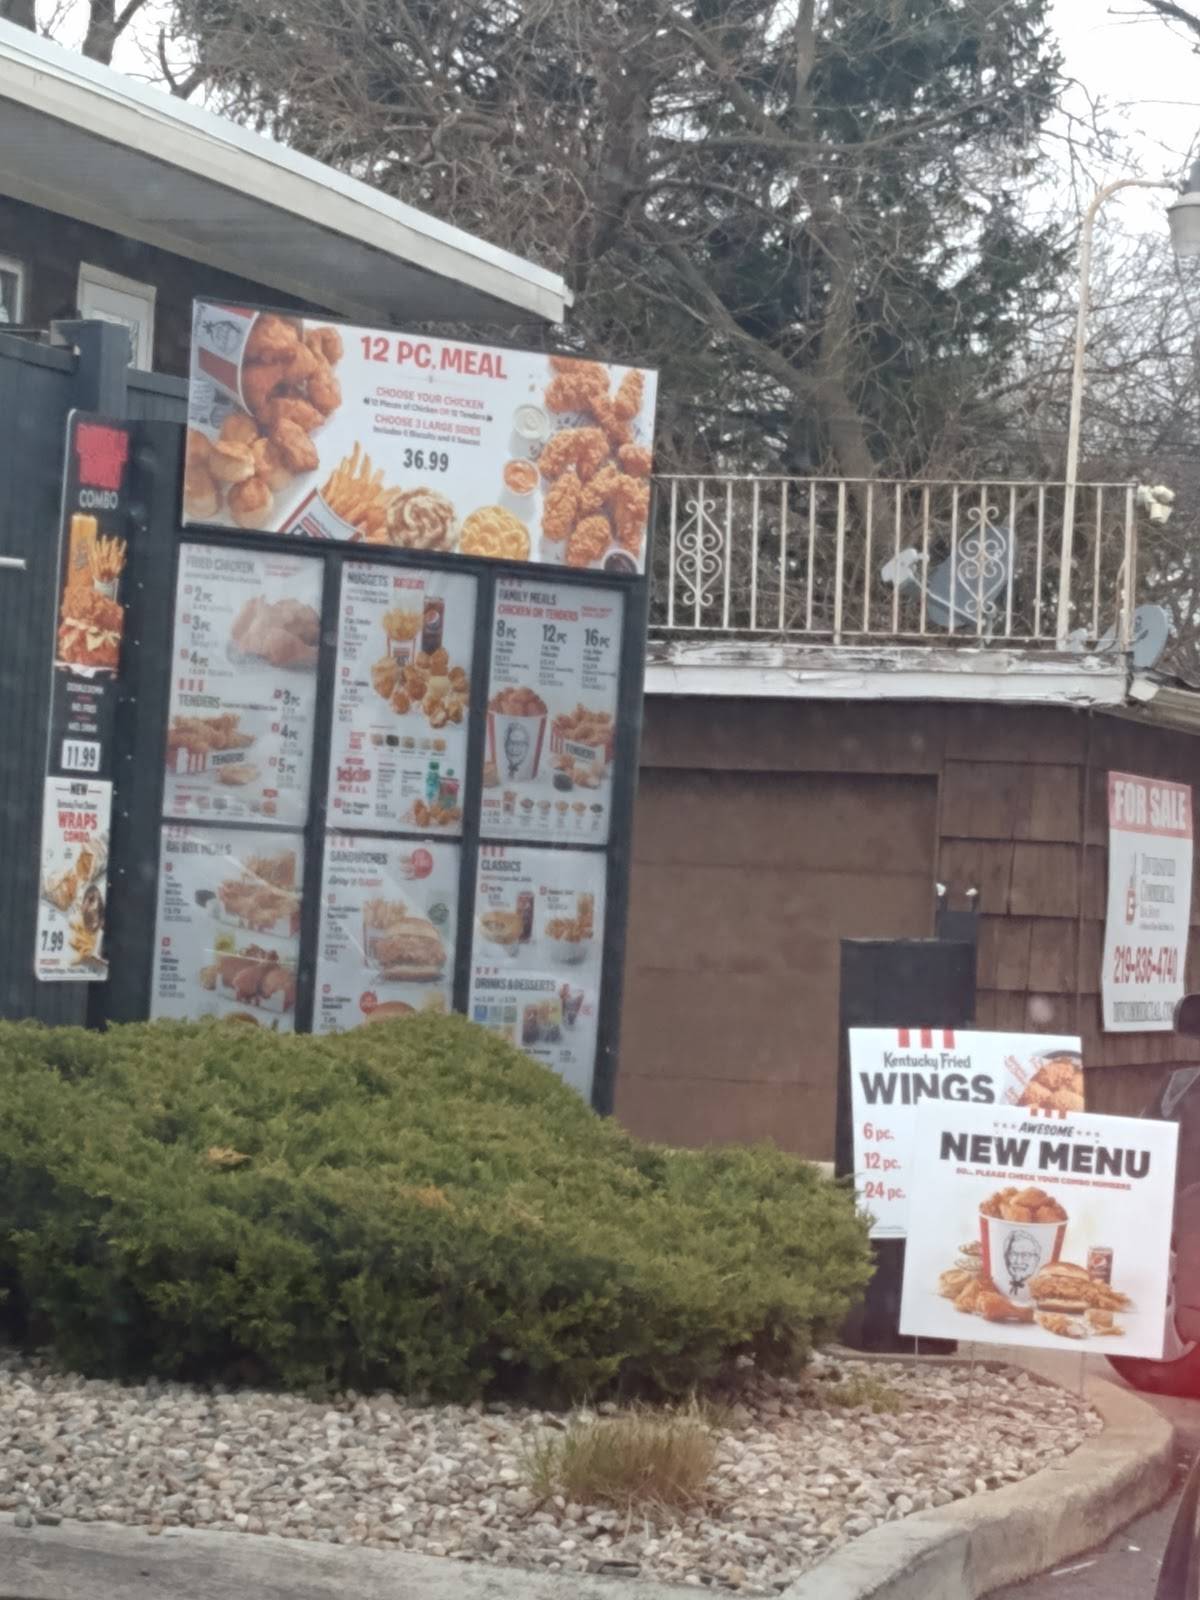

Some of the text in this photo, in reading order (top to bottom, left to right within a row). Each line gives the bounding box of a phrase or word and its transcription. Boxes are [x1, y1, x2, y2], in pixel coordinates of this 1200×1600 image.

[361, 336, 508, 380] 12 PC. MEAL
[376, 386, 485, 410] CHOOSE YOUR CHICKEN
[380, 399, 402, 409] Pieces
[403, 402, 411, 411] of
[412, 403, 438, 414] Chicken
[439, 407, 450, 415] OR
[460, 410, 486, 421] Tenders
[373, 425, 402, 436] Includes
[437, 434, 450, 443] and
[375, 413, 414, 428] CHOOSE
[422, 419, 453, 432] LARGE
[455, 424, 481, 436] SIDES
[403, 447, 449, 472] 36.99
[79, 489, 119, 510] COMBO
[186, 555, 213, 570] FRIED
[214, 558, 255, 574] CHICKEN
[499, 588, 557, 606] FAMILY MEALS
[498, 604, 531, 617] CHICKEN
[178, 694, 221, 709] TENDERS
[67, 745, 96, 768] 11.99
[70, 783, 88, 796] NEW
[1114, 780, 1186, 830] FOR SALE
[57, 811, 98, 830] WRAPS
[64, 831, 90, 843] COMBO
[481, 859, 521, 873] CLASSICS
[41, 930, 64, 951] 7.99
[474, 977, 507, 990] DRINKS
[513, 979, 556, 992] DESSERTS
[883, 1051, 971, 1071] Kentucky Fried
[860, 1071, 996, 1105] WINGS
[863, 1122, 894, 1142] 6 pc.
[1018, 1121, 1075, 1138] AWESOME
[864, 1152, 902, 1172] 12 pc.
[939, 1130, 1151, 1180] NEW MENU
[975, 1169, 1006, 1180] PLEASE
[1008, 1172, 1036, 1182] CHECK
[1038, 1174, 1060, 1184] YOUR
[1061, 1177, 1090, 1187] COMBO
[1092, 1180, 1132, 1191] NUMBERS
[865, 1181, 906, 1202] 24 pc.
